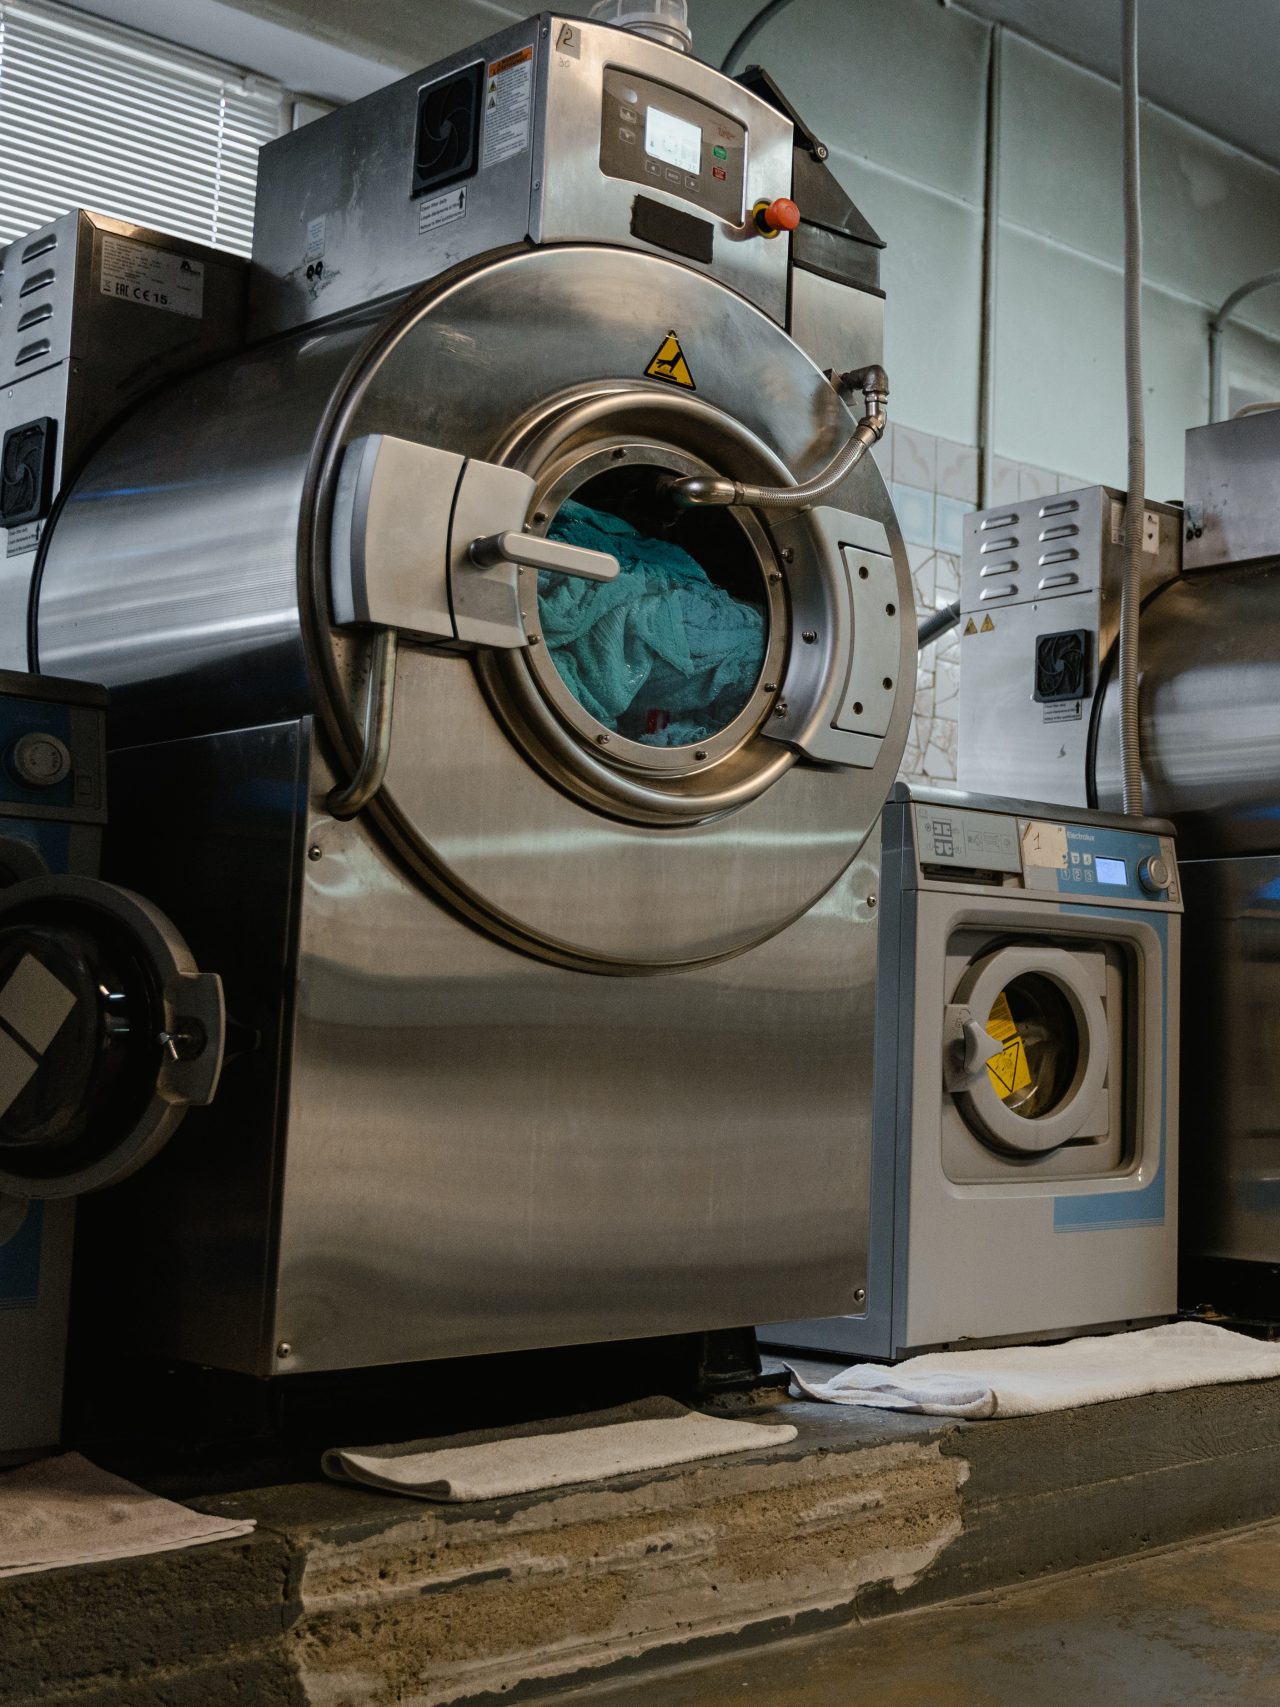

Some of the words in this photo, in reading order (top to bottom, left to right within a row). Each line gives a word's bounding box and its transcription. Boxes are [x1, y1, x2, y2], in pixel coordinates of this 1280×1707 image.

[563, 28, 575, 48] 2
[1034, 832, 1042, 851] 1
[1067, 831, 1094, 841] Electrolux
